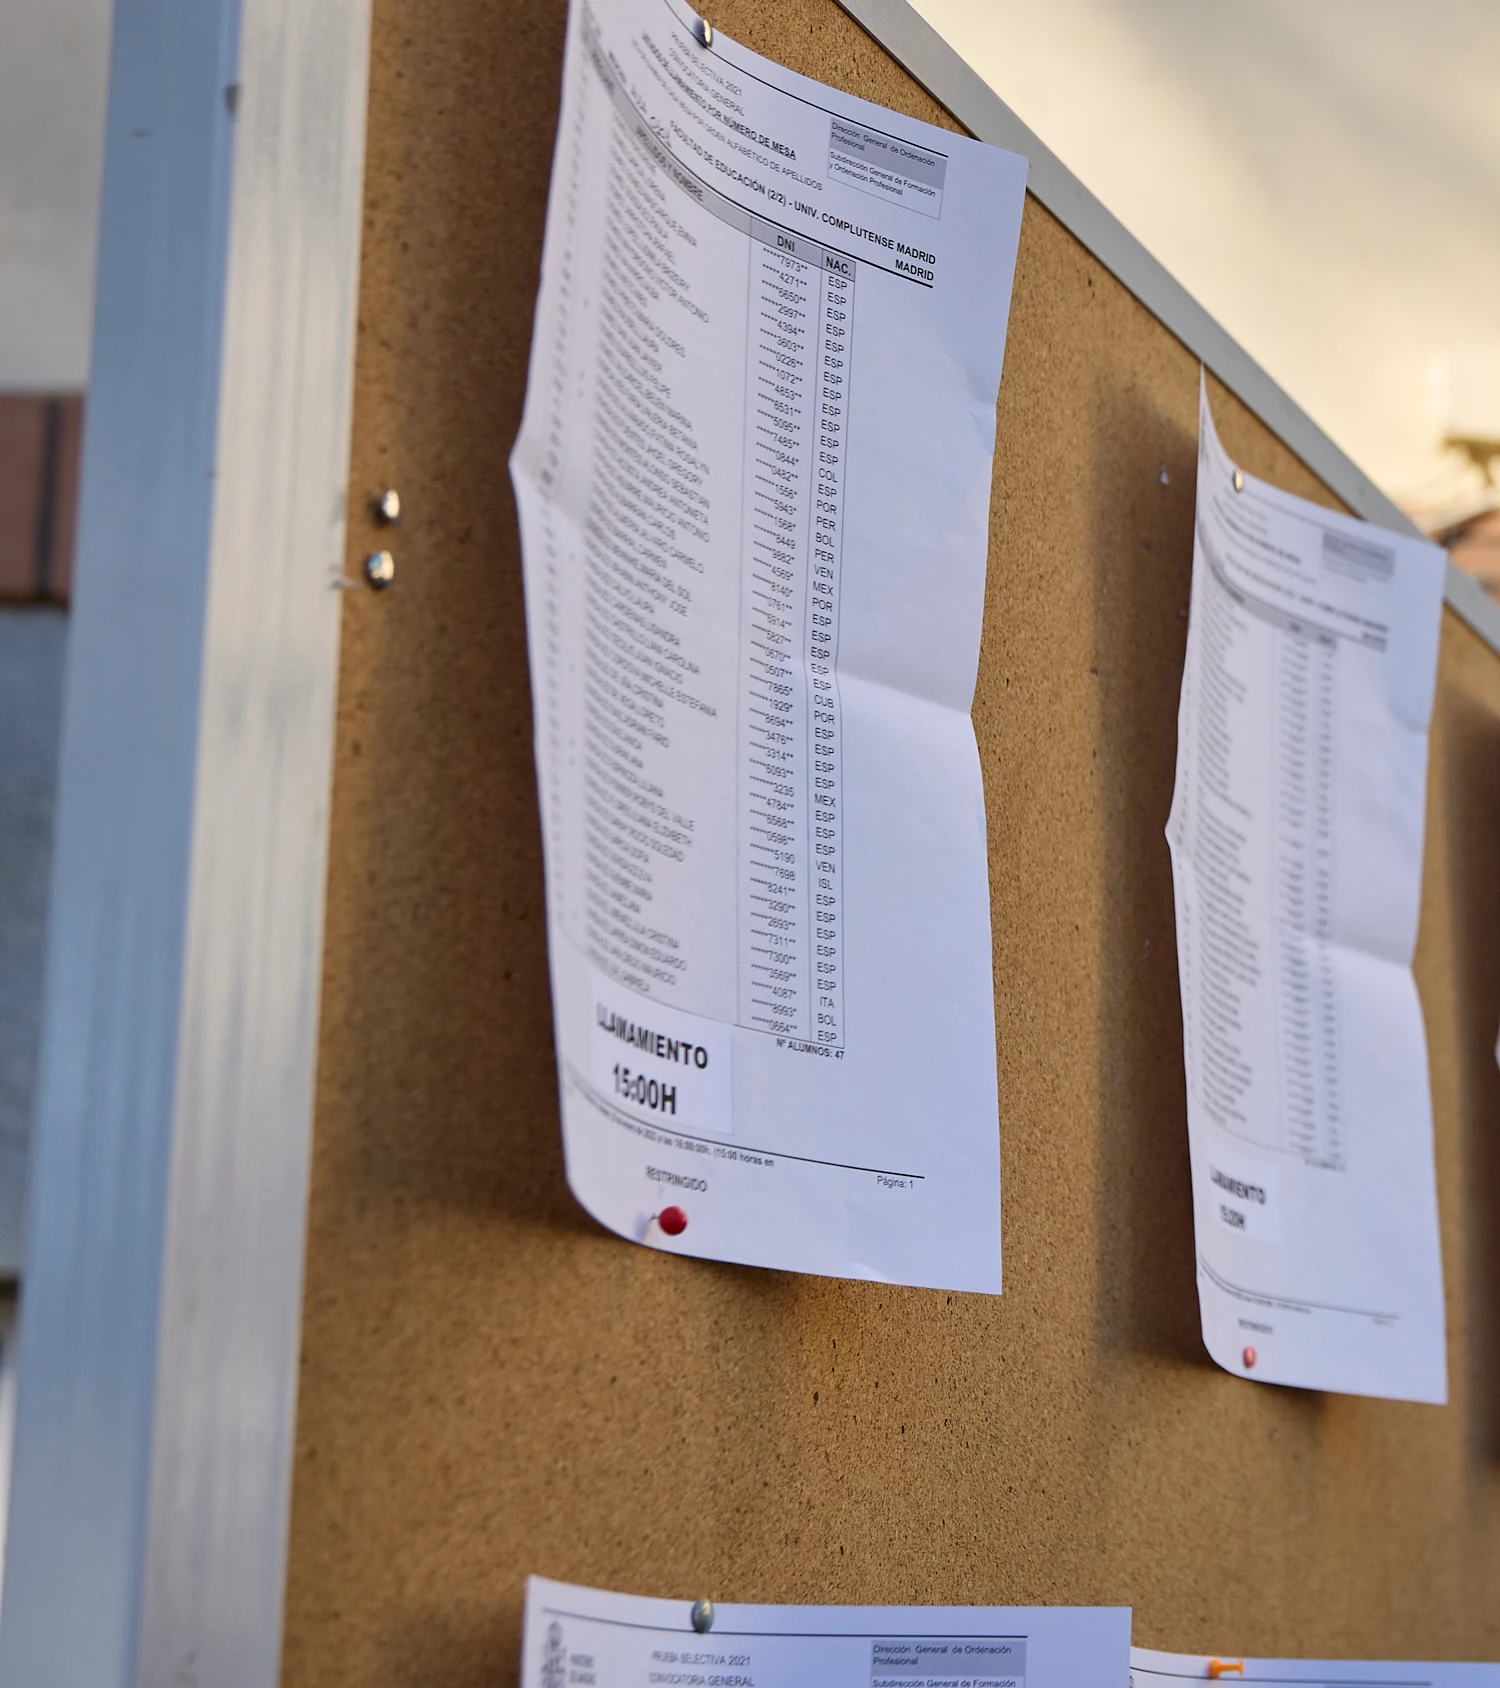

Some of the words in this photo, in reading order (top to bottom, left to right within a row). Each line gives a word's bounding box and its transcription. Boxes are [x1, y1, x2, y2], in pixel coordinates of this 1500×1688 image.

[725, 81, 742, 97] 2021
[711, 86, 745, 116] GENERAL
[707, 104, 722, 123] POR
[724, 115, 757, 142] NÚMERO
[758, 134, 770, 148] DE
[772, 141, 796, 160] MESA
[832, 132, 865, 151] Profesional
[832, 122, 861, 139] Dirección
[863, 134, 888, 149] General
[900, 148, 936, 167] Ordenación
[705, 122, 725, 143] ORDEN
[726, 138, 768, 167] ALFABÉTICO
[770, 161, 780, 173] DE
[782, 168, 822, 191] APELLIDOS
[830, 152, 868, 173] Subdirección
[870, 168, 893, 182] General
[904, 180, 936, 197] Formación
[834, 164, 868, 182] Ordenación
[870, 177, 903, 196] Profesional
[670, 120, 703, 156] FACULTAD
[703, 150, 714, 166] DE
[715, 159, 766, 196] EDUCACIÓN
[768, 190, 787, 207] (2/2)
[794, 200, 819, 220] UNIV.
[822, 213, 894, 249] COMPLUTENSE
[896, 243, 936, 265] MADRID
[673, 167, 704, 201] NOMBRE
[777, 235, 795, 252] DNI
[826, 256, 851, 276] NAC.
[895, 260, 934, 281] MADRID
[828, 276, 847, 290] ESP
[827, 291, 847, 306] ESP
[826, 308, 846, 322] ESP
[826, 324, 845, 338] ESP
[825, 339, 844, 354] ESP
[824, 355, 843, 370] ESP
[823, 371, 842, 386] ESP
[823, 387, 842, 401] ESP
[822, 403, 841, 417] ESP
[821, 419, 840, 433] ESP
[820, 435, 839, 449] ESP
[819, 451, 839, 465] ESP
[818, 468, 838, 483] COL
[818, 484, 837, 497] ESP
[816, 500, 837, 515] POR
[816, 516, 836, 531] PER
[816, 532, 834, 548] BOL
[815, 548, 834, 564] PER
[814, 565, 834, 580] VEN
[813, 581, 834, 596] MEX
[812, 597, 833, 612] POR
[812, 614, 832, 627] ESP
[812, 630, 831, 644] ESP
[811, 647, 830, 659] ESP
[811, 663, 829, 676] ESP
[813, 679, 832, 692] ESP
[814, 694, 834, 708] CUB
[814, 711, 835, 725] POR
[815, 727, 834, 739] ESP
[815, 744, 834, 756] ESP
[815, 760, 835, 773] ESP
[815, 777, 835, 790] ESP
[814, 794, 836, 808] MEX
[816, 810, 835, 823] ESP
[816, 827, 836, 839] ESP
[816, 843, 836, 856] ESP
[816, 861, 836, 873] VEN
[818, 878, 833, 890] ISL
[816, 894, 835, 906] ESP
[816, 911, 836, 923] ESP
[816, 928, 836, 940] ESP
[817, 944, 836, 957] ESP
[817, 961, 836, 974] ESP
[817, 979, 836, 991] ESP
[819, 996, 835, 1009] ITA
[818, 1013, 837, 1027] BOL
[597, 1002, 708, 1071] LLAMAMIENTO
[818, 1030, 837, 1043] ESP
[788, 1040, 832, 1057] ALUMNOS:
[835, 1050, 844, 1060] 47
[612, 1063, 676, 1115] 15:00H
[739, 1152, 762, 1165] horas
[645, 1166, 707, 1193] RESTRINGIDO
[877, 1175, 907, 1190] Página:
[873, 1645, 911, 1654] Dirección
[916, 1646, 948, 1654] General
[952, 1646, 962, 1654] de
[964, 1645, 1012, 1655] Ordenación
[652, 1651, 678, 1663] PRUEBA
[681, 1653, 726, 1666] SELECTIVA
[728, 1655, 751, 1666] 2021
[873, 1657, 918, 1666] Profesional
[708, 1676, 754, 1687] GENERAL
[873, 1679, 924, 1688] Subdirección
[926, 1679, 958, 1688] General
[960, 1680, 971, 1688] de
[973, 1679, 1016, 1688] Formación
